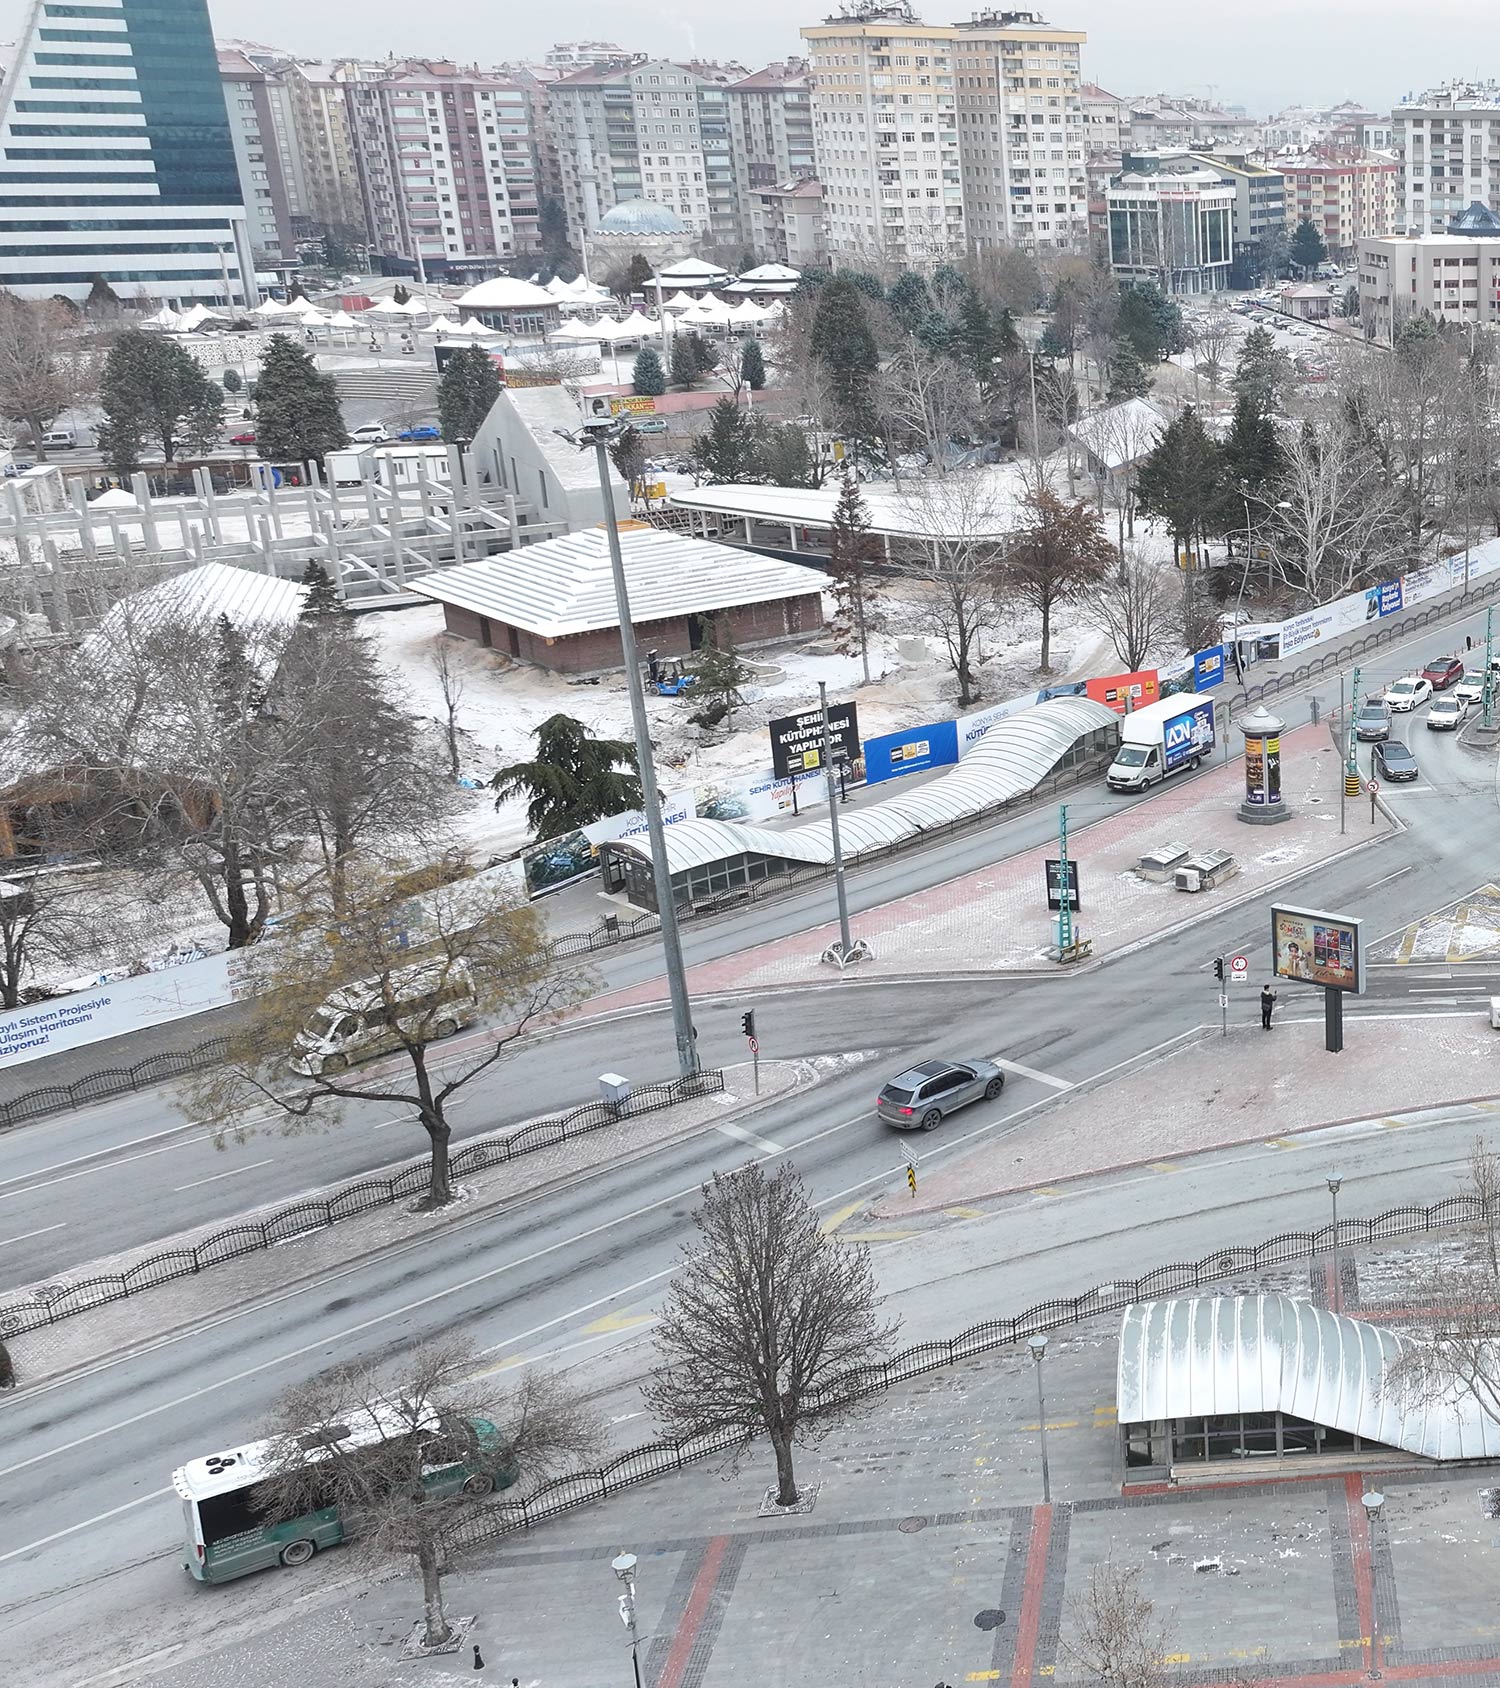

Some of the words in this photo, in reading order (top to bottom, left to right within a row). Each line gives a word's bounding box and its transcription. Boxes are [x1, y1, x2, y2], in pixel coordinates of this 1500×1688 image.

[779, 716, 850, 744] KÜTÜPHNESİ
[972, 715, 992, 728] KONYA
[789, 733, 843, 754] YAPILIYOR
[19, 1009, 58, 1029] Sistem
[58, 994, 112, 1022] Projesiyle
[39, 1013, 94, 1034] Haritasını
